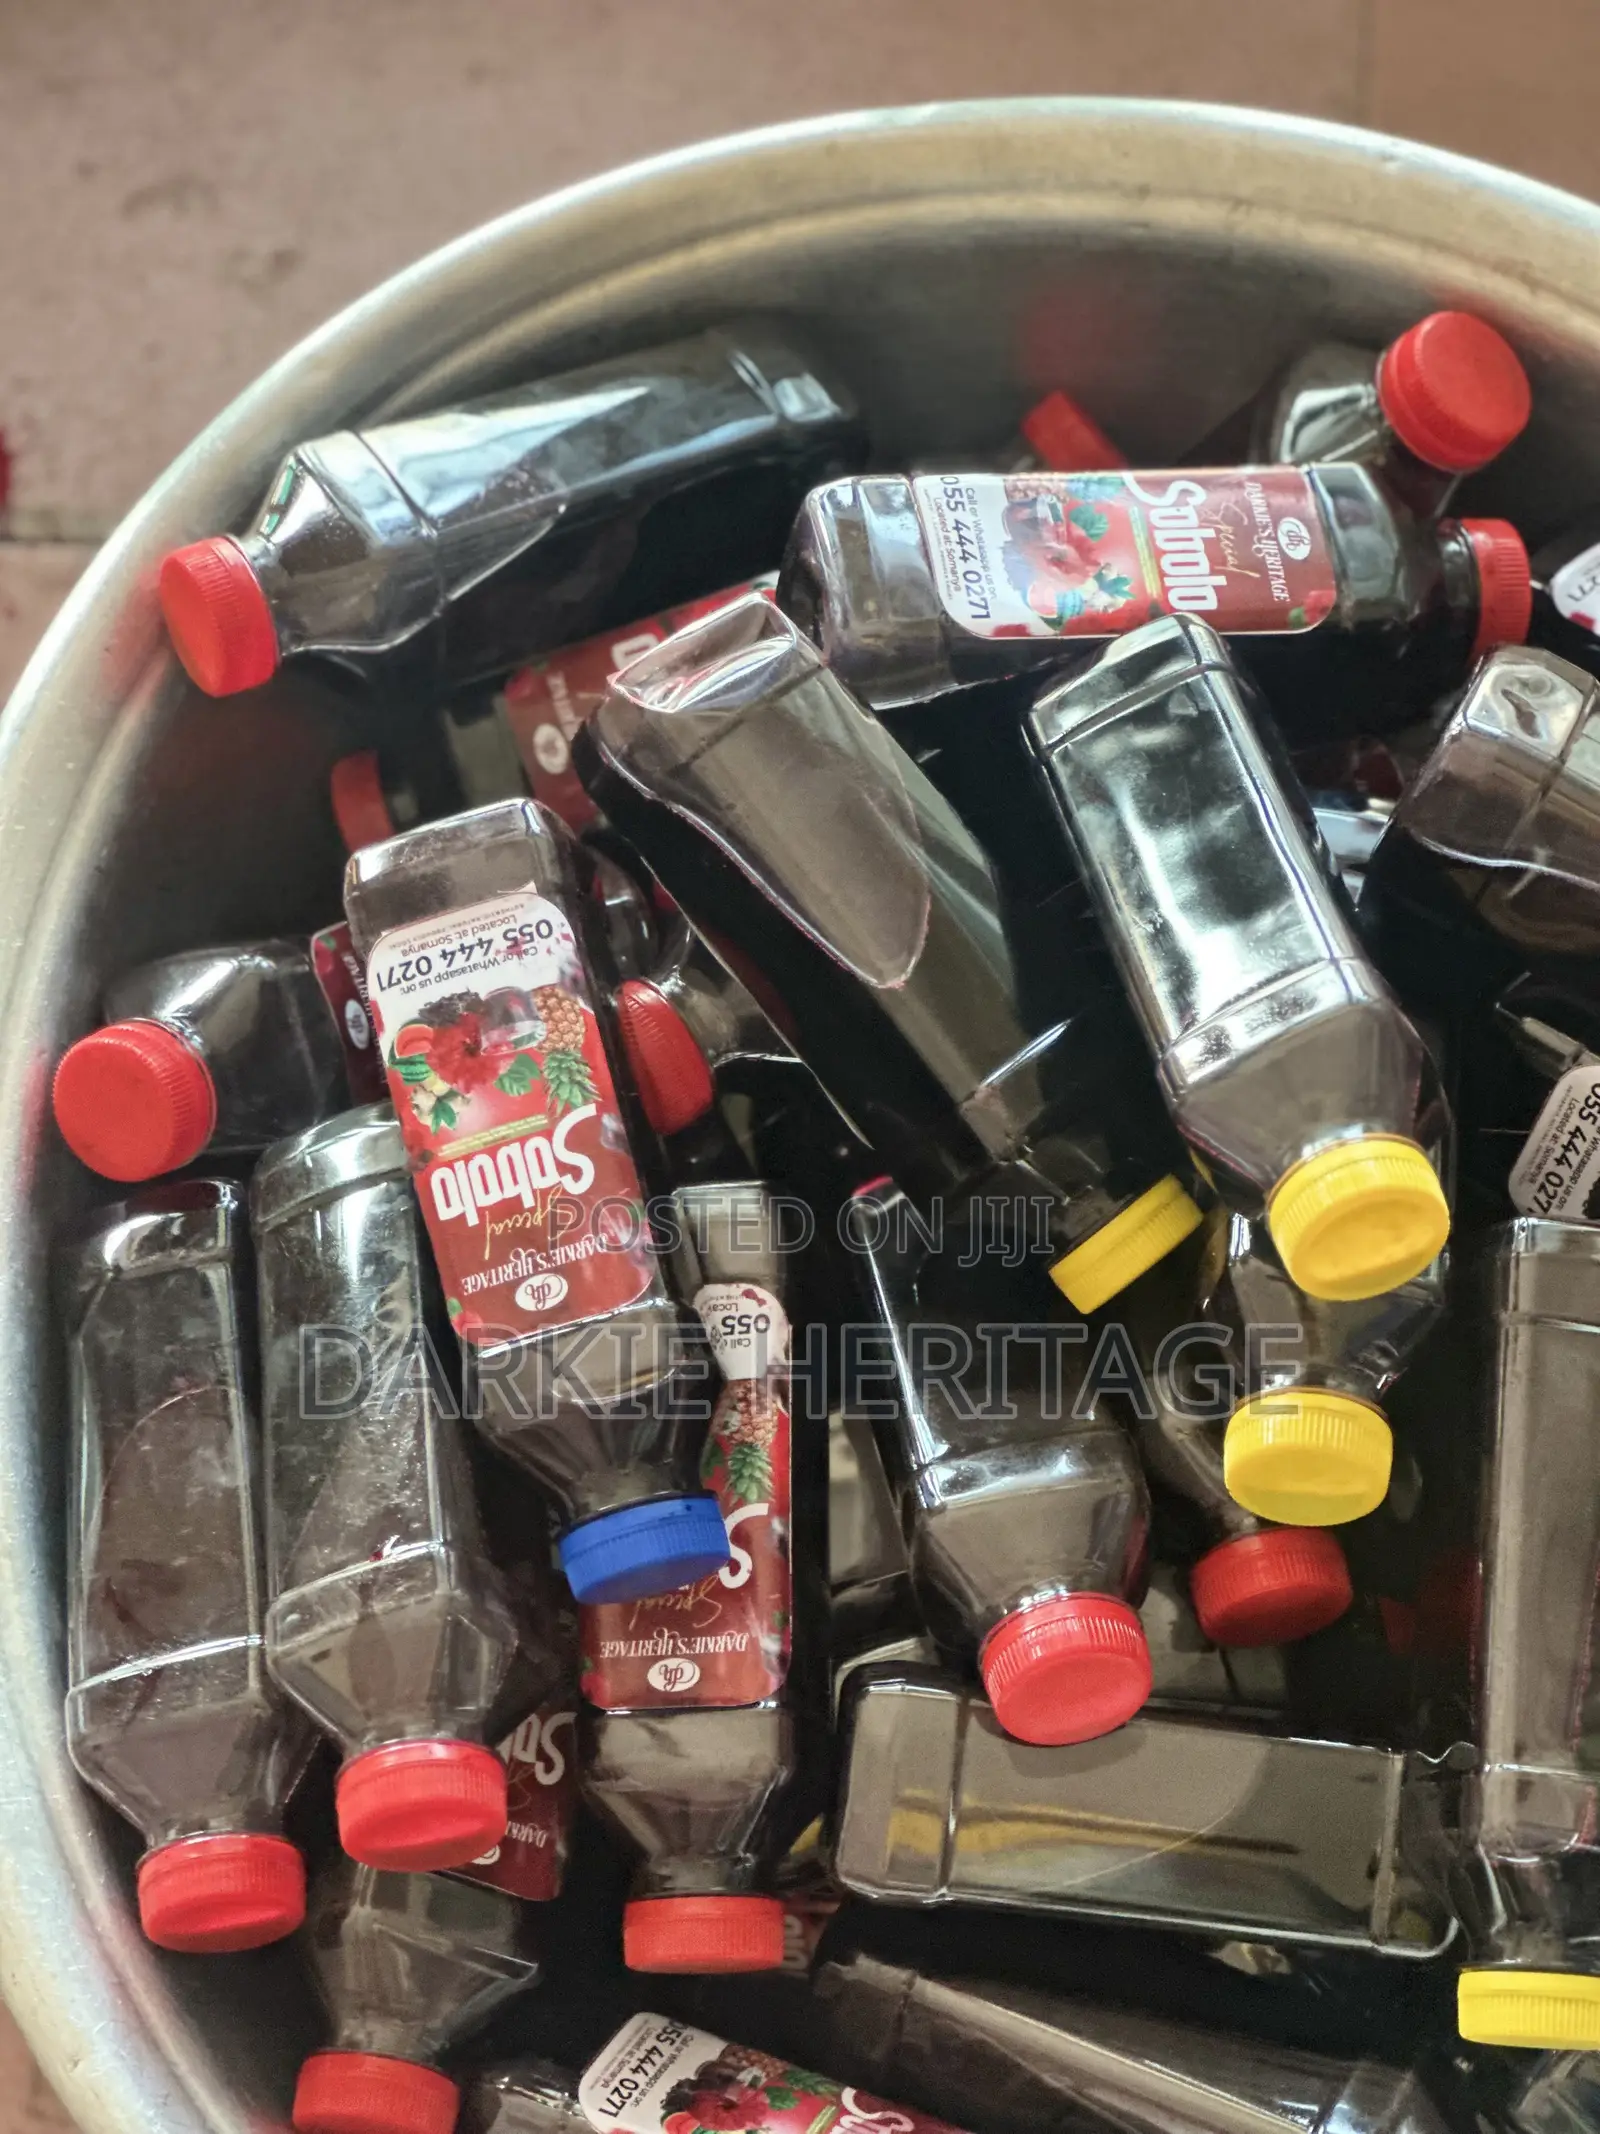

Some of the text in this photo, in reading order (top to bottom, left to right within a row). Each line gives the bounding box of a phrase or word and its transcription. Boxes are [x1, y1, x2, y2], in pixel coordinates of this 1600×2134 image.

[934, 497, 951, 534] Located
[940, 476, 991, 619] 055 444 0271
[966, 487, 978, 505] Call
[985, 575, 995, 586] us
[1121, 472, 1227, 611] Sobolo
[1199, 501, 1261, 578] Special
[1244, 482, 1290, 603] DARKIE'S HERITAGE
[471, 914, 517, 936] Located
[376, 918, 553, 992] 055 444 0271
[401, 933, 453, 957] Somanya
[502, 952, 514, 963] or
[516, 946, 538, 961] Call
[418, 975, 432, 987] us
[434, 955, 501, 983] Whatasapp
[1556, 1097, 1581, 1135] Located
[431, 1103, 597, 1227] Sobolo
[1554, 1125, 1587, 1170] 444
[1527, 1171, 1564, 1214] 027
[1563, 1184, 1574, 1196] us
[484, 1184, 573, 1261] Special
[461, 1233, 608, 1296] DARKIE'S HERITAGE
[721, 1313, 771, 1336] 055
[730, 1338, 751, 1349] Call
[600, 1627, 750, 1658] DARKIE'S HERITAGE
[629, 2045, 665, 2077] 444
[598, 2078, 639, 2118] 0271
